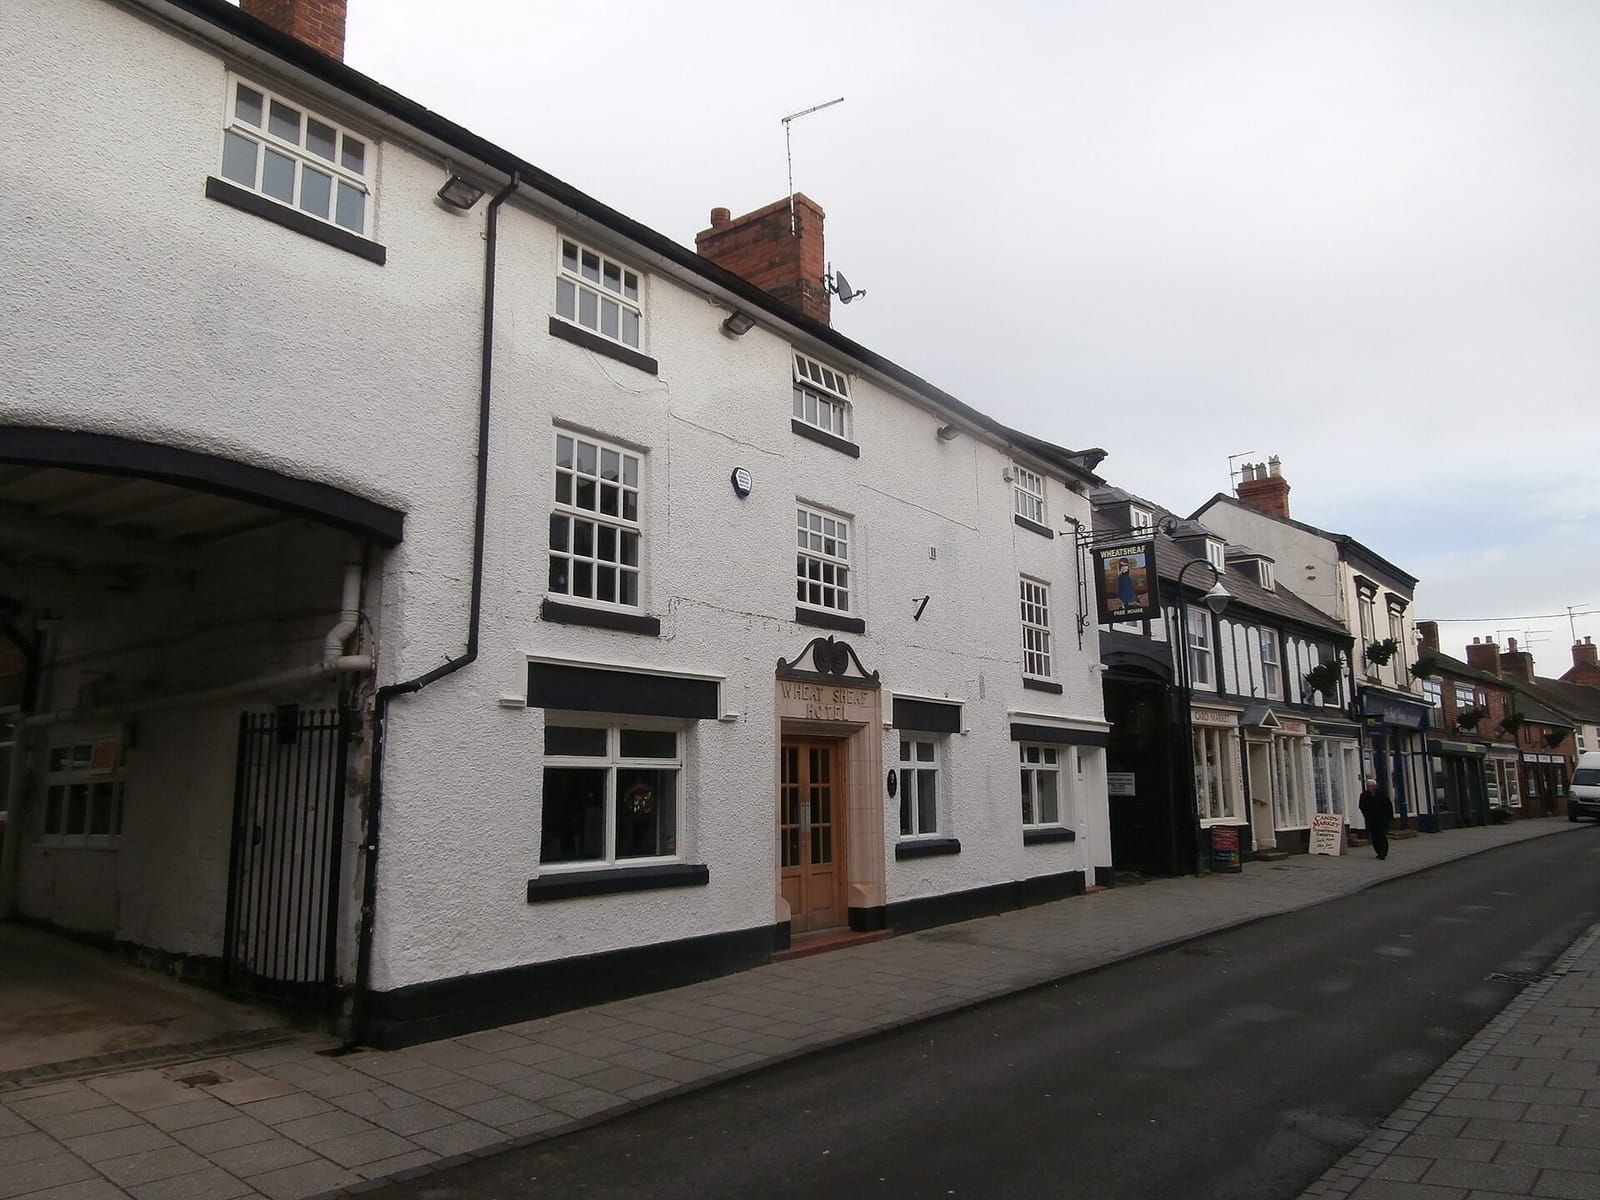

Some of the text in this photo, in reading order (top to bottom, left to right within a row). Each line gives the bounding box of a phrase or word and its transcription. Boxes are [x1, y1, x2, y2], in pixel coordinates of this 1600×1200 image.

[1100, 545, 1146, 558] WHEATSHEAF
[781, 682, 868, 706] WHEAT SHEAF
[806, 704, 848, 720] HOTEL
[1312, 820, 1340, 828] MARKET
